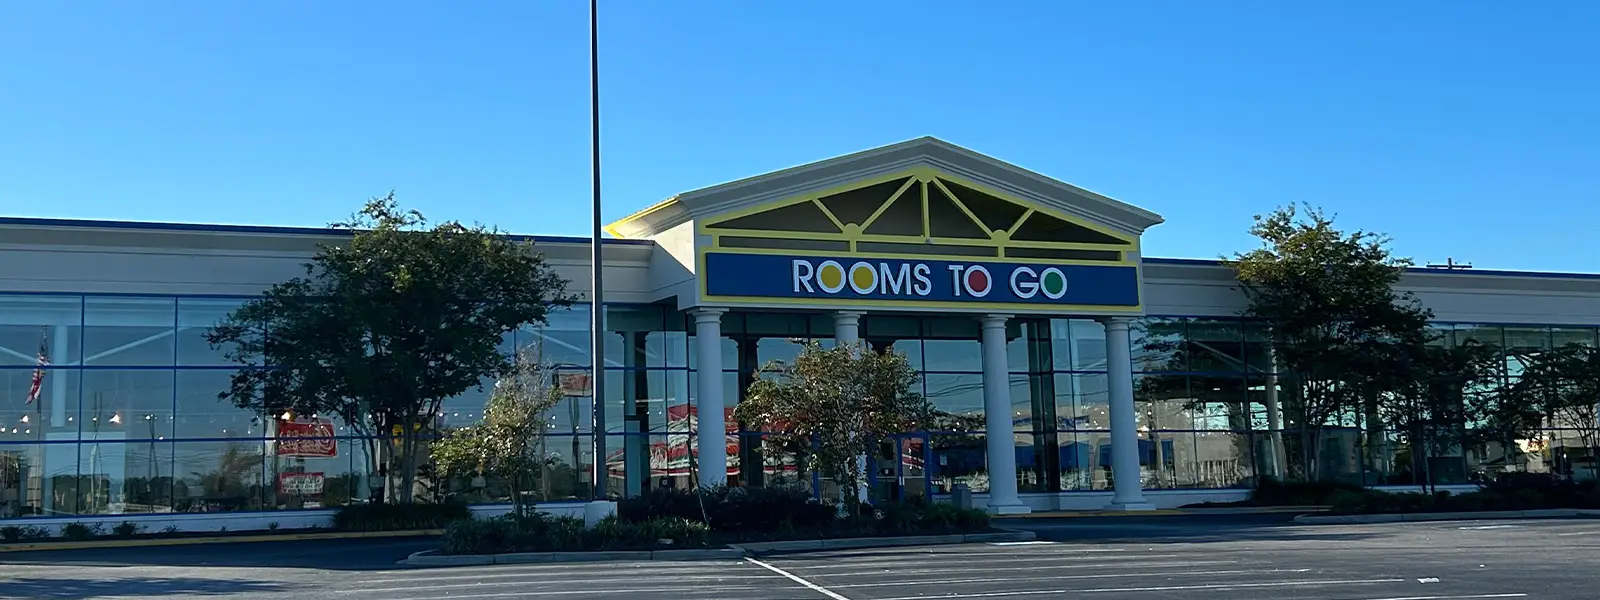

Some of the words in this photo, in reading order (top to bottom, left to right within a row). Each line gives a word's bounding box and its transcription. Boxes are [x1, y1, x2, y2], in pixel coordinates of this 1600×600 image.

[792, 259, 932, 295] ROOMS
[949, 265, 992, 297] TO
[1010, 266, 1068, 299] GO
